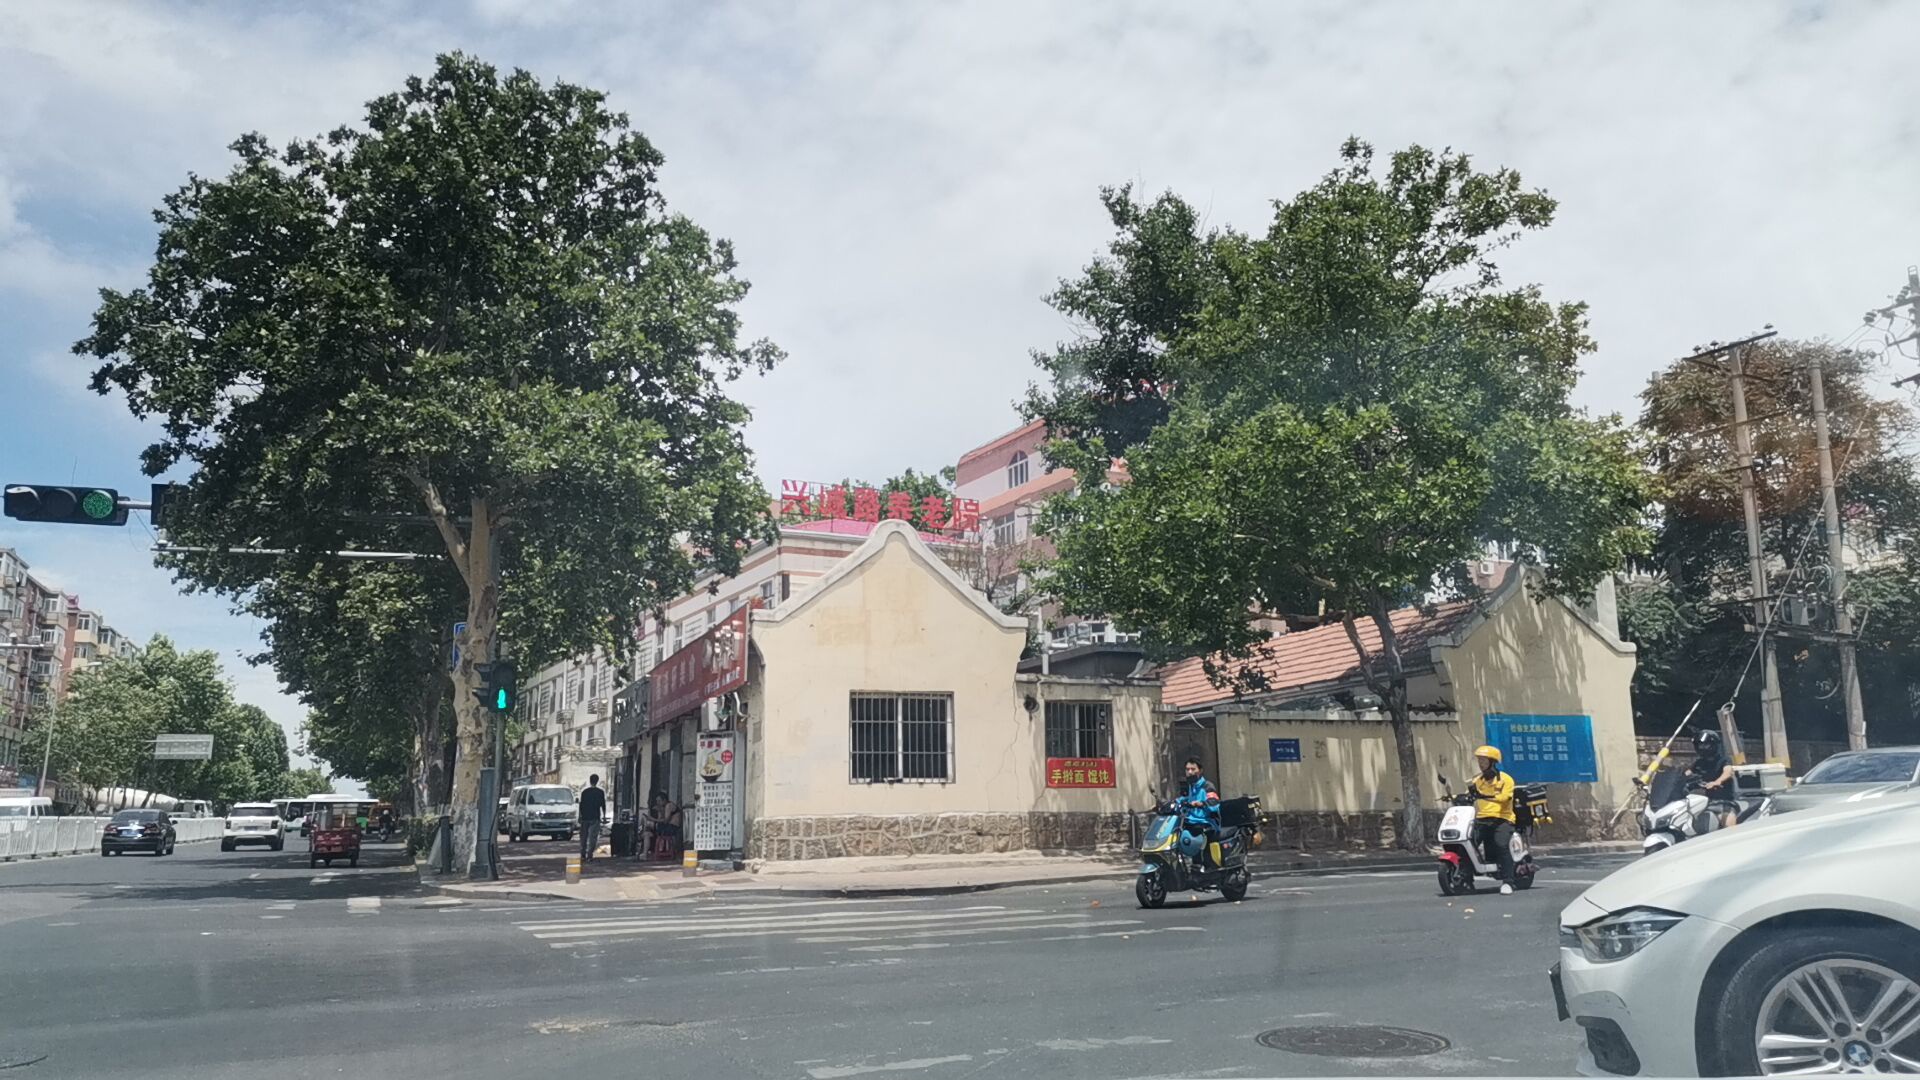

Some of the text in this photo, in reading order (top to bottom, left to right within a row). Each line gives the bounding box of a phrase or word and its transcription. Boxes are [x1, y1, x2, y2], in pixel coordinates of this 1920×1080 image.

[782, 479, 980, 531] 兴城路养老院
[1088, 769, 1110, 784] 馄饨
